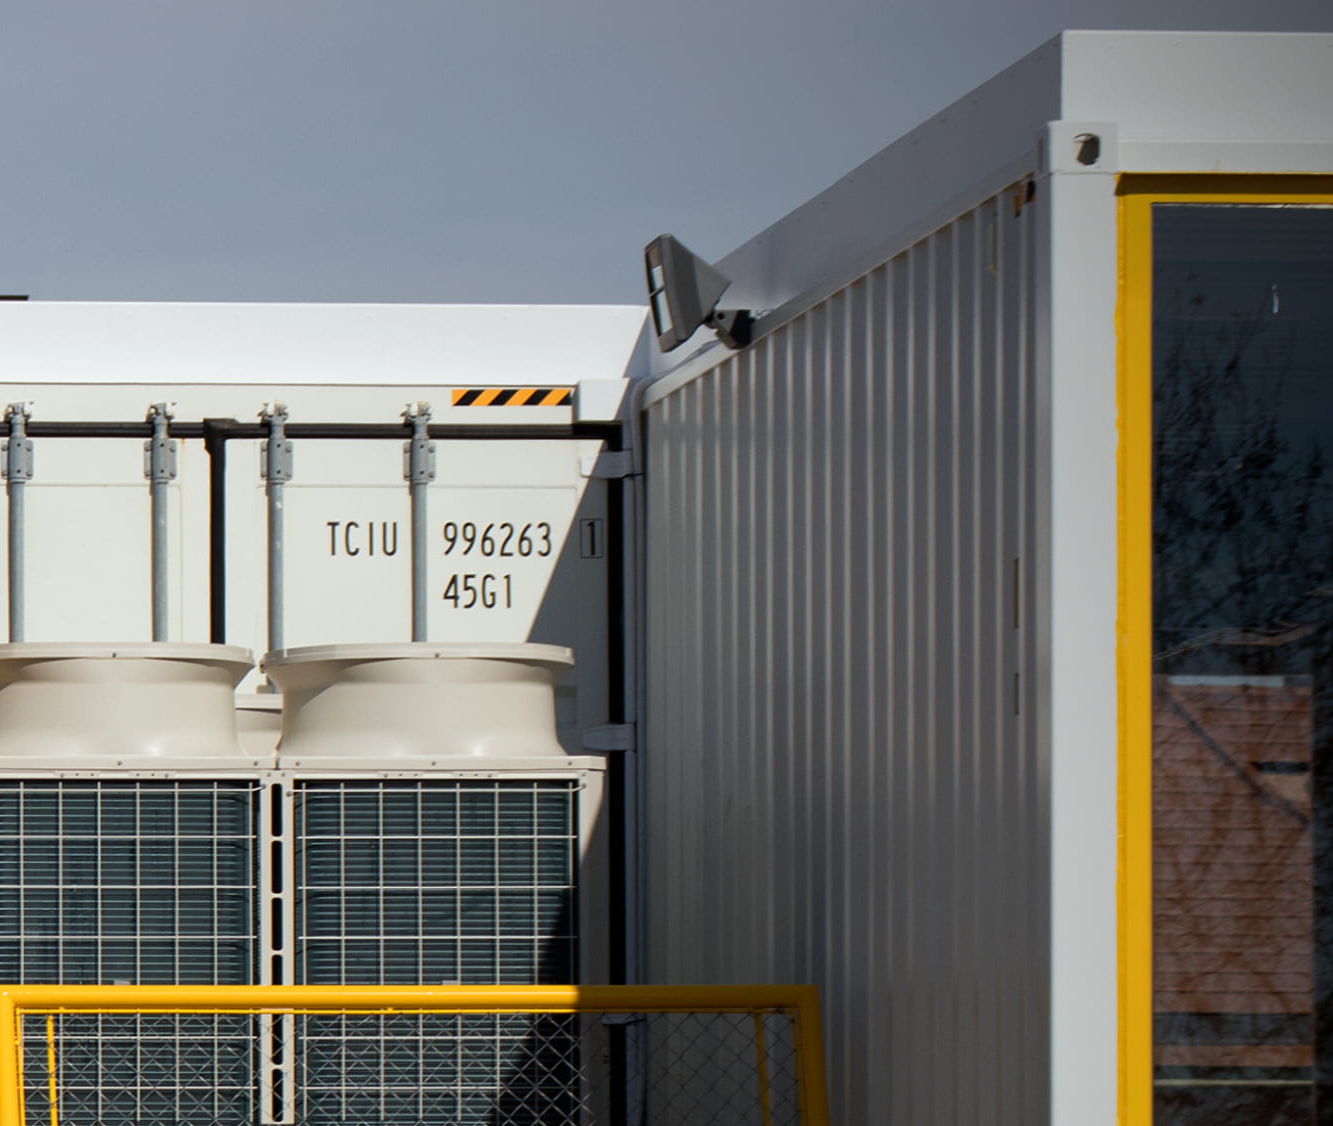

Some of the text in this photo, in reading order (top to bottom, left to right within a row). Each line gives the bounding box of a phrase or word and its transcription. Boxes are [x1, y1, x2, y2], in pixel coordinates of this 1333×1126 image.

[327, 521, 596, 557] TCIU 996263 1
[443, 574, 511, 608] 45G1
